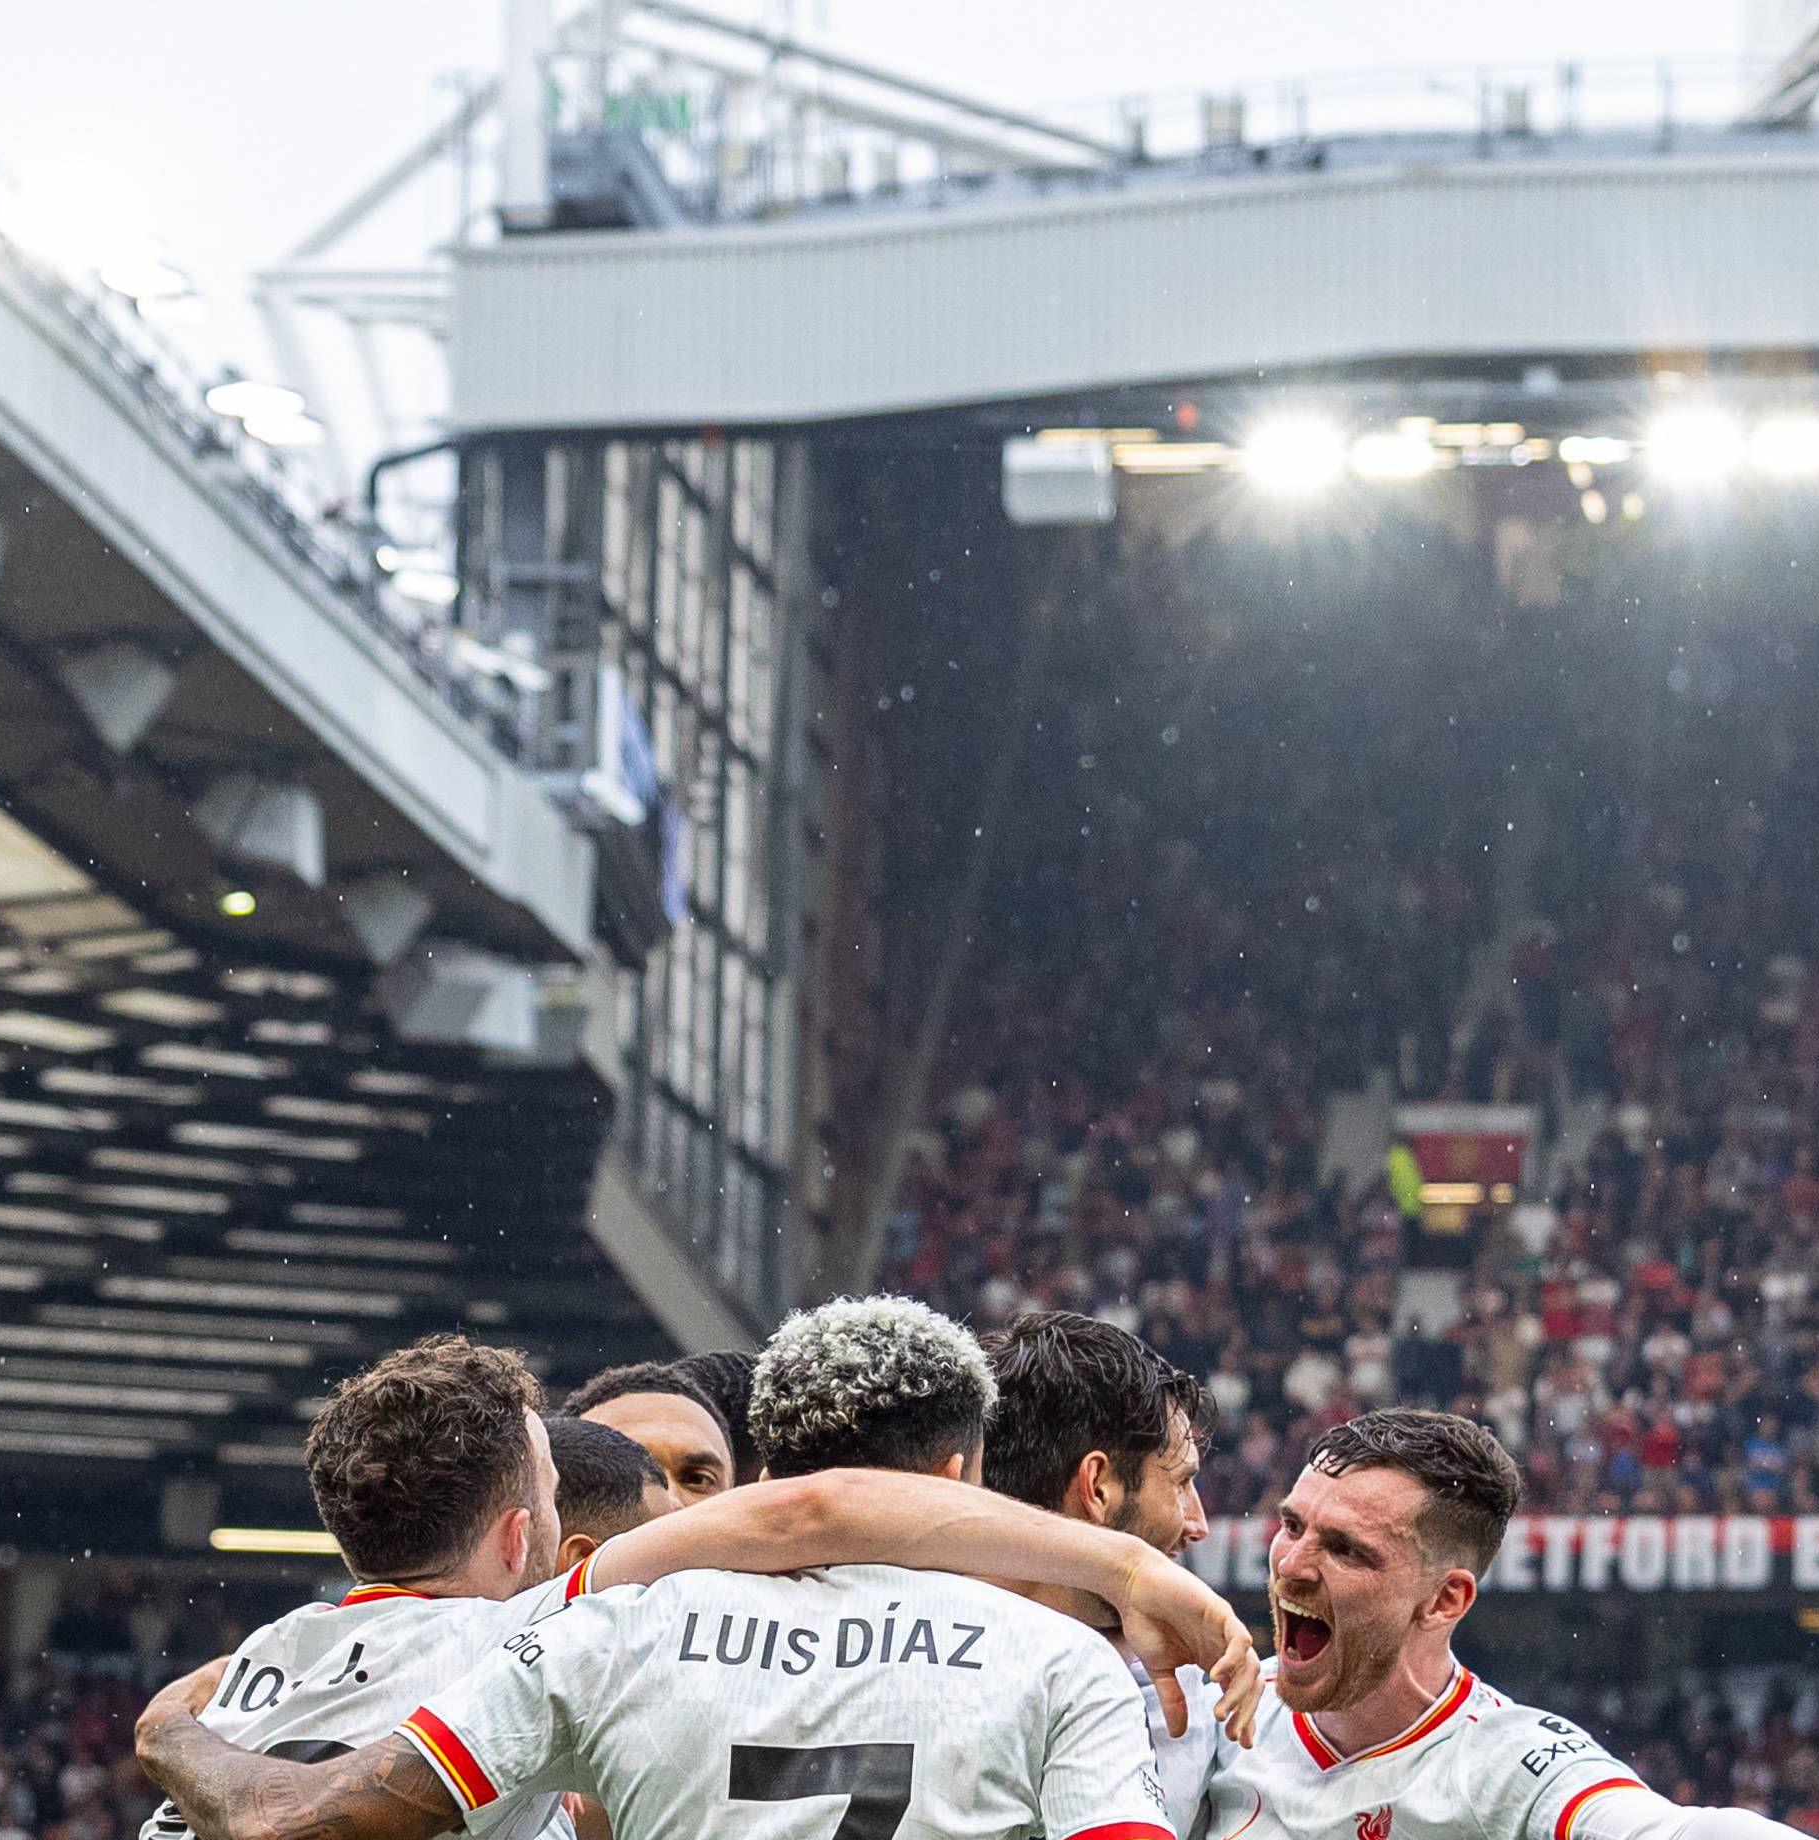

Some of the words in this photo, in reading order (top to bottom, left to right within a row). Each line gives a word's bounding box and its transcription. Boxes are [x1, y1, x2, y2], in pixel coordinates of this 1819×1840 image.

[1493, 1517, 1769, 1589] ETFORD
[678, 1612, 820, 1675] LUIS
[835, 1601, 985, 1669] DÍAZ
[1521, 1739, 1593, 1777] Exp
